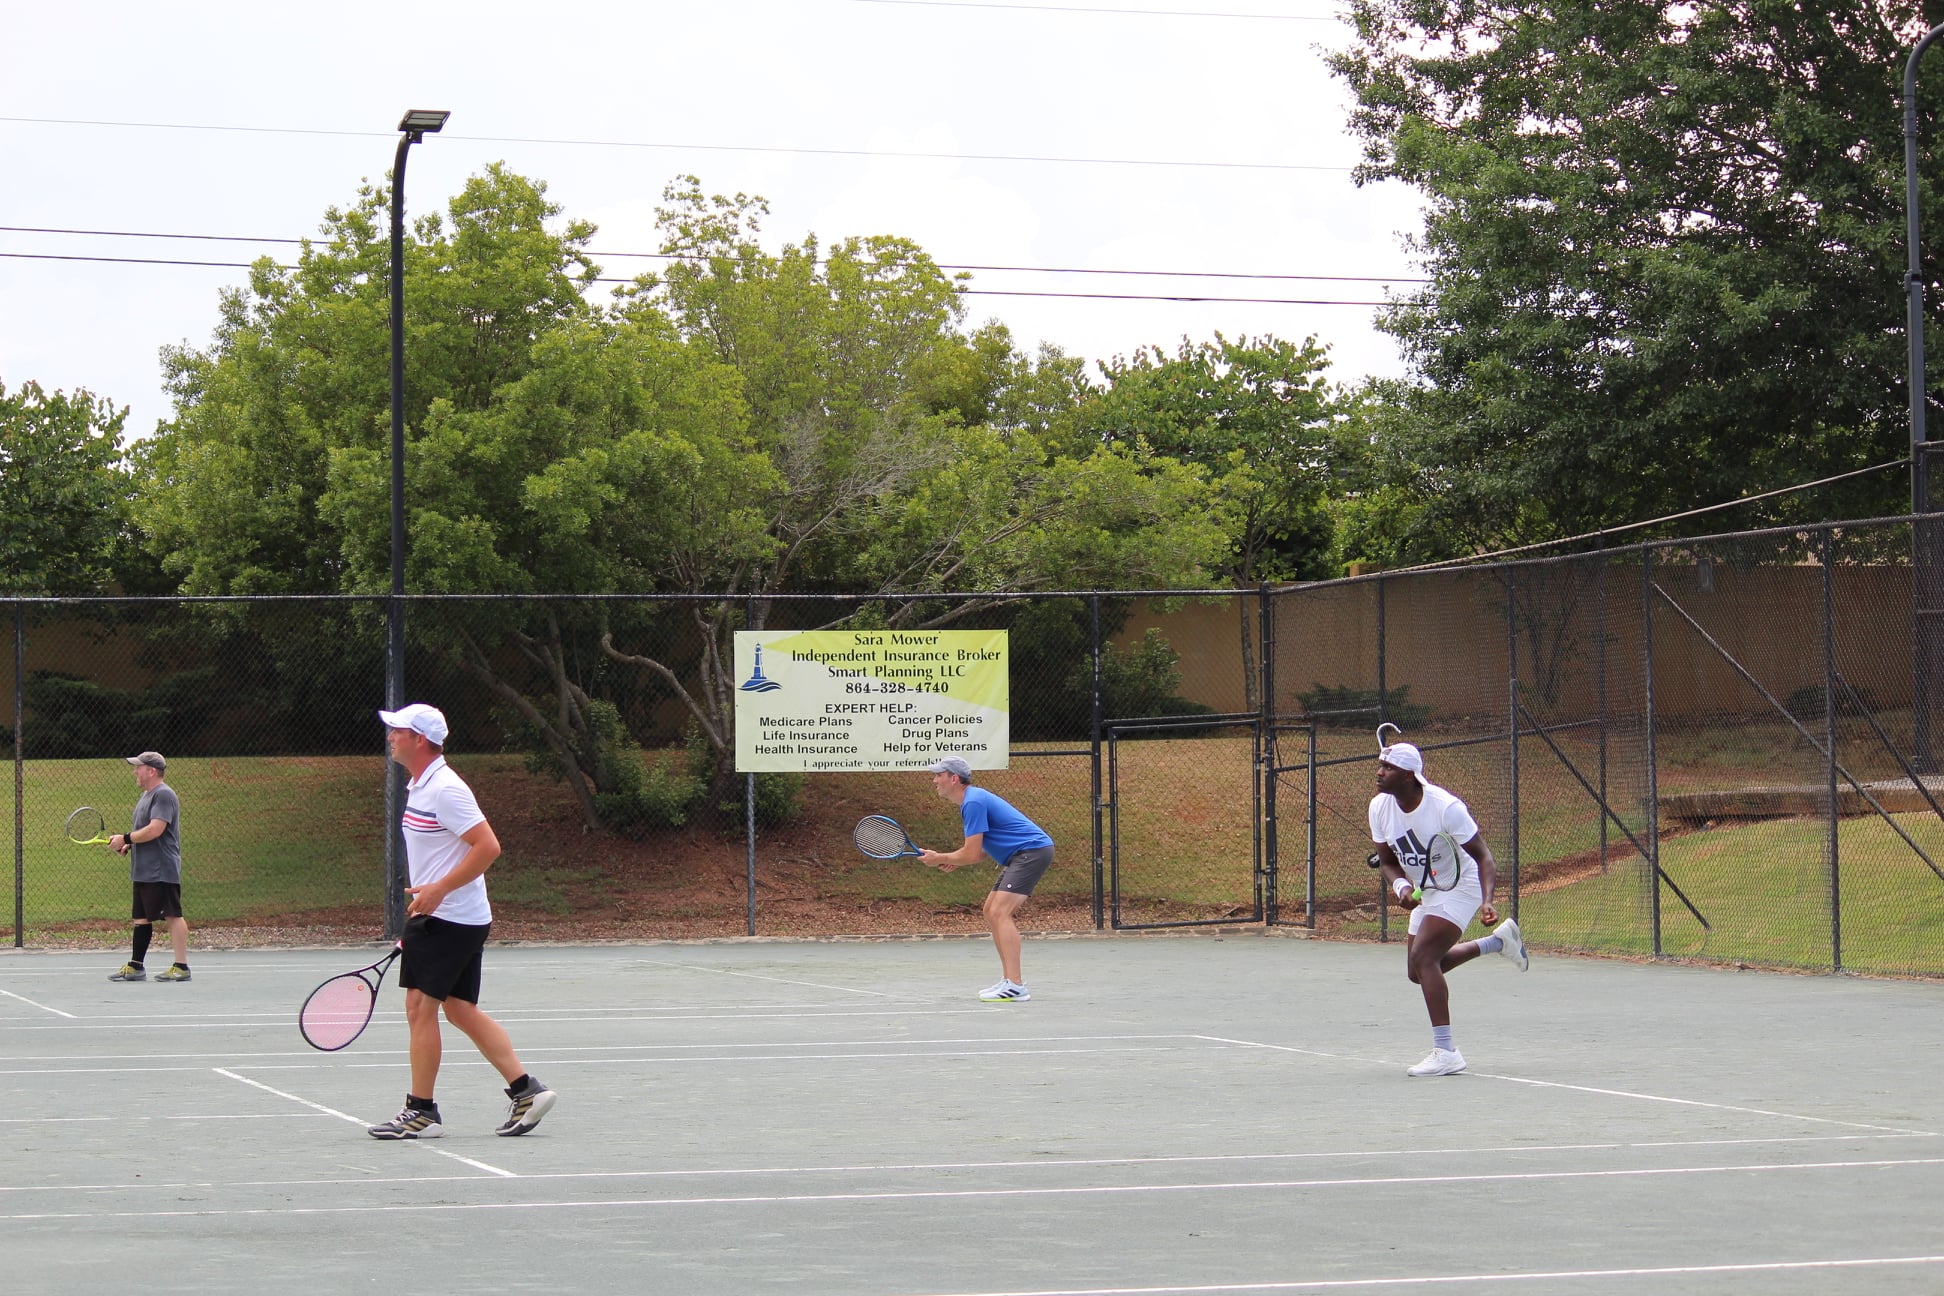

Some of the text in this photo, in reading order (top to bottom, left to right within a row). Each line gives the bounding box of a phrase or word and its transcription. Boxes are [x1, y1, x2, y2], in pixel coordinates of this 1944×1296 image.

[854, 633, 939, 646] Sara Mower
[792, 648, 1001, 664] Independent Insurance Broker
[828, 664, 965, 681] Smart Planning LLC
[845, 681, 949, 694] 864-328-4740
[825, 703, 917, 714] EXPERT HELP:
[759, 716, 853, 727] Medicare Plans
[888, 714, 983, 725] Cancer Policies
[763, 730, 850, 741] Life Insurance
[902, 728, 969, 741] Drug Plans
[755, 744, 858, 755] Health Insurance
[883, 741, 988, 755] Help for Veterans
[812, 758, 863, 770] appreciate
[868, 760, 890, 769] your
